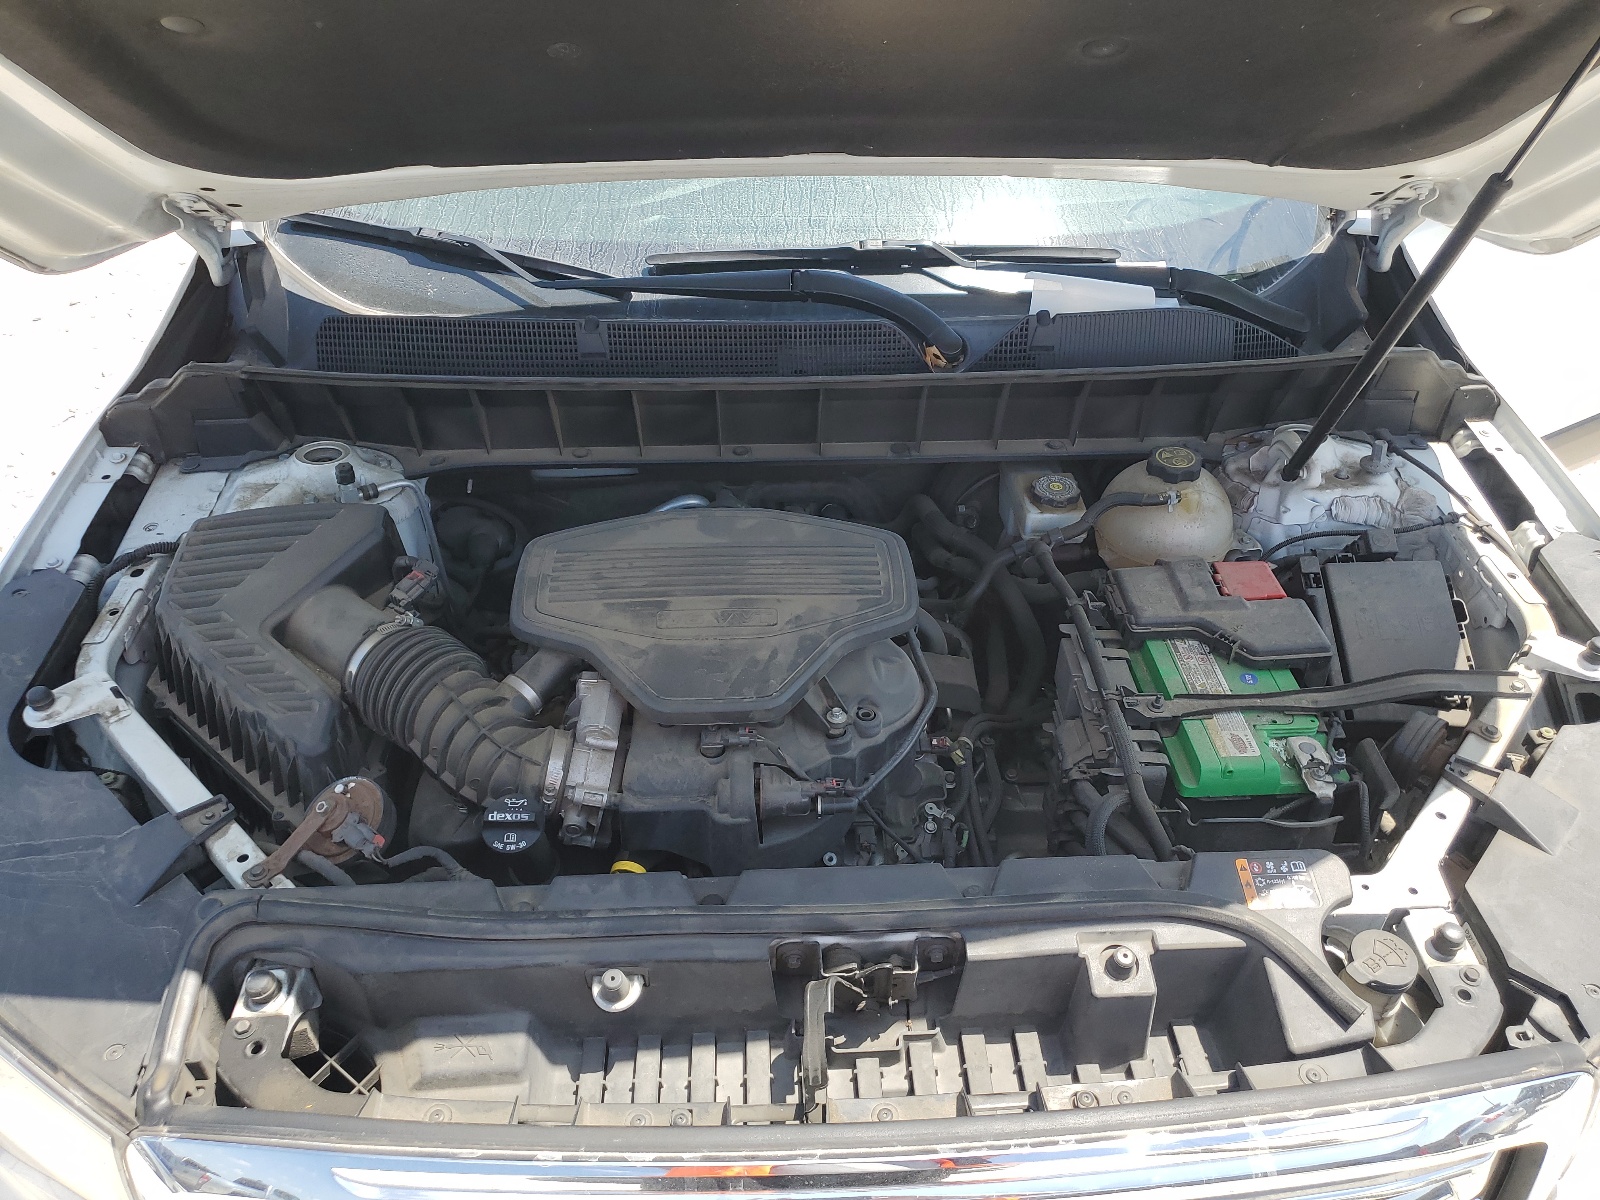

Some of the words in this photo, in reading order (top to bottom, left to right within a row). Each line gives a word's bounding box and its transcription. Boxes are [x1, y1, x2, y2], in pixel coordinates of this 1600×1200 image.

[488, 811, 531, 821] dexos
[493, 840, 505, 850] SAE
[506, 840, 527, 851] 5W-30
